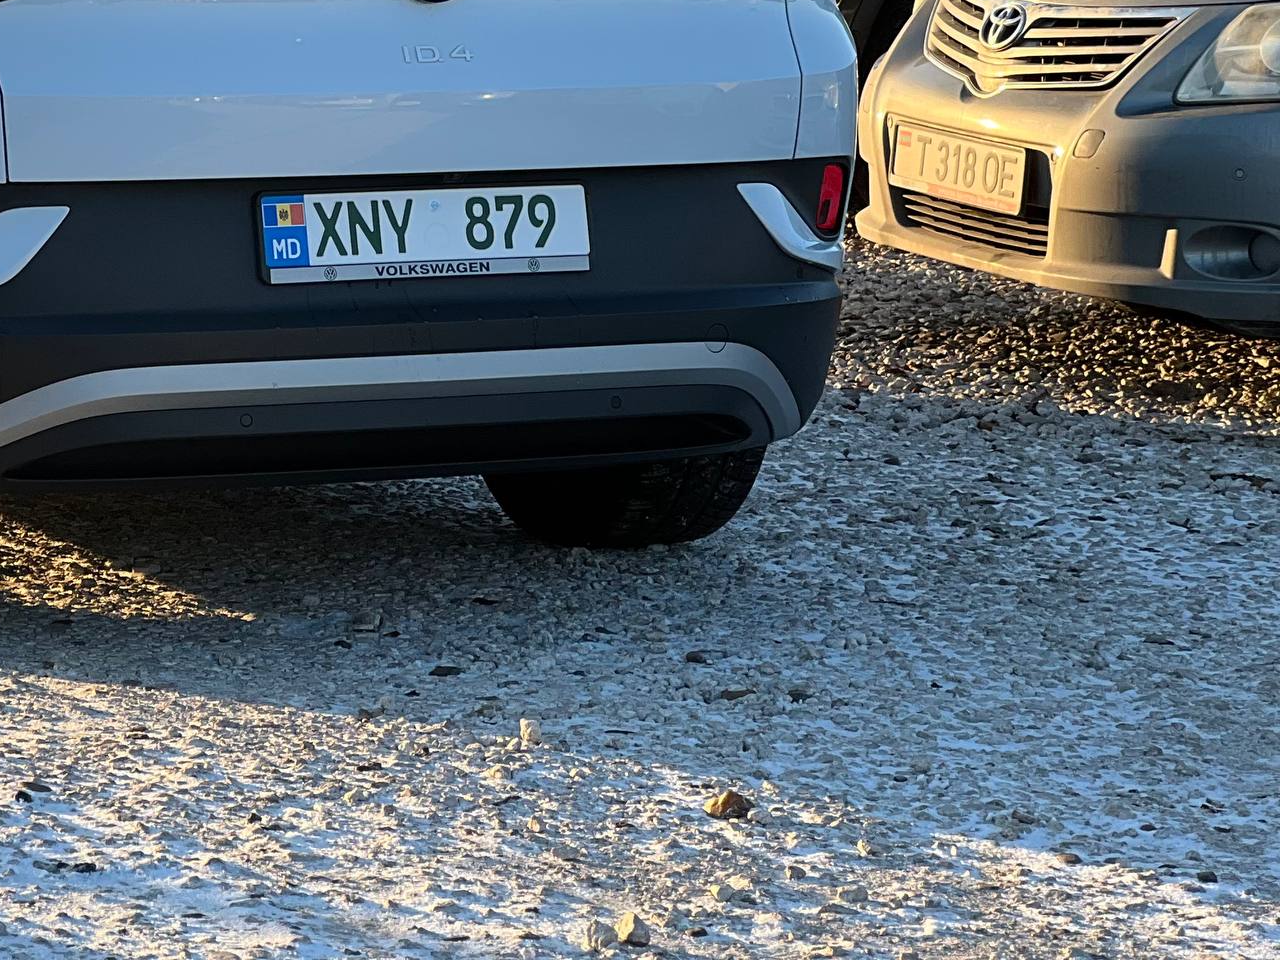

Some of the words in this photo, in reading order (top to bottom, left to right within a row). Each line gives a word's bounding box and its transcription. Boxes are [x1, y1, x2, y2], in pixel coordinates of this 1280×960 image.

[917, 135, 932, 176] T
[935, 141, 977, 188] 318
[313, 198, 413, 257] XNY
[465, 194, 557, 250] 879
[272, 238, 302, 260] MD
[375, 261, 490, 277] VOLKSWAGEN
